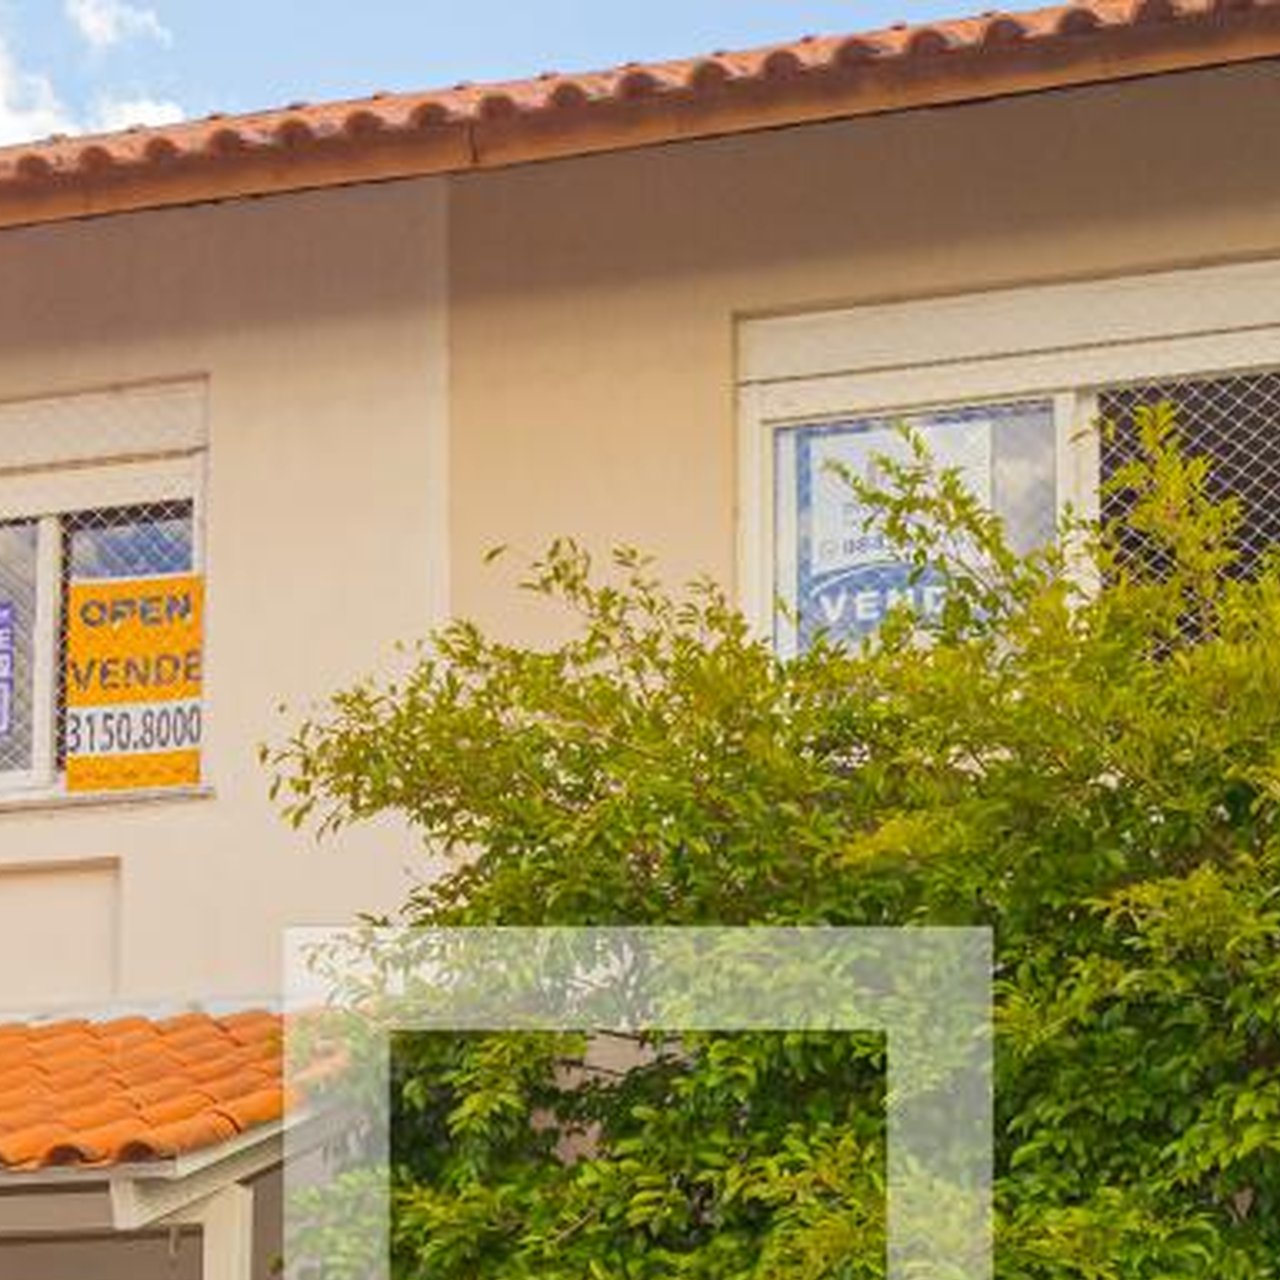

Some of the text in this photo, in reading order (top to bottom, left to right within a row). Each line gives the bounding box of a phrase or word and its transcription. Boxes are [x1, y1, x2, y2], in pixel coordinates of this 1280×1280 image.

[79, 592, 192, 628] OPEN
[69, 650, 202, 692] VENDE
[67, 704, 202, 753] 3150.8000
